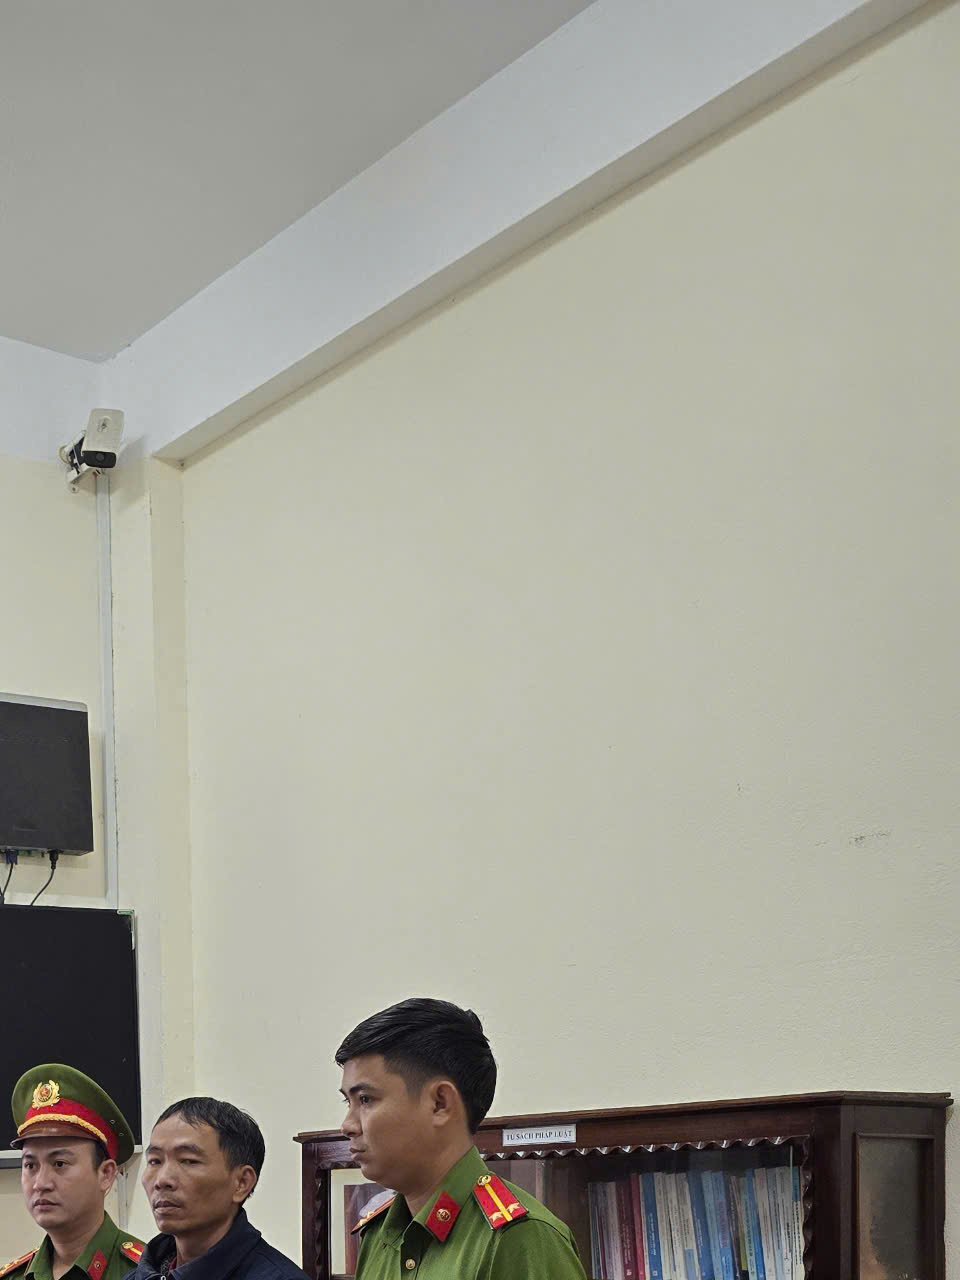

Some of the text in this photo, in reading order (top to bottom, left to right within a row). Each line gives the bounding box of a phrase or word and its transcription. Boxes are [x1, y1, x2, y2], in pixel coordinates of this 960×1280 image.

[516, 1131, 534, 1140] SÁCH
[535, 1130, 553, 1139] PHÁP
[554, 1129, 572, 1138] LUẬT
